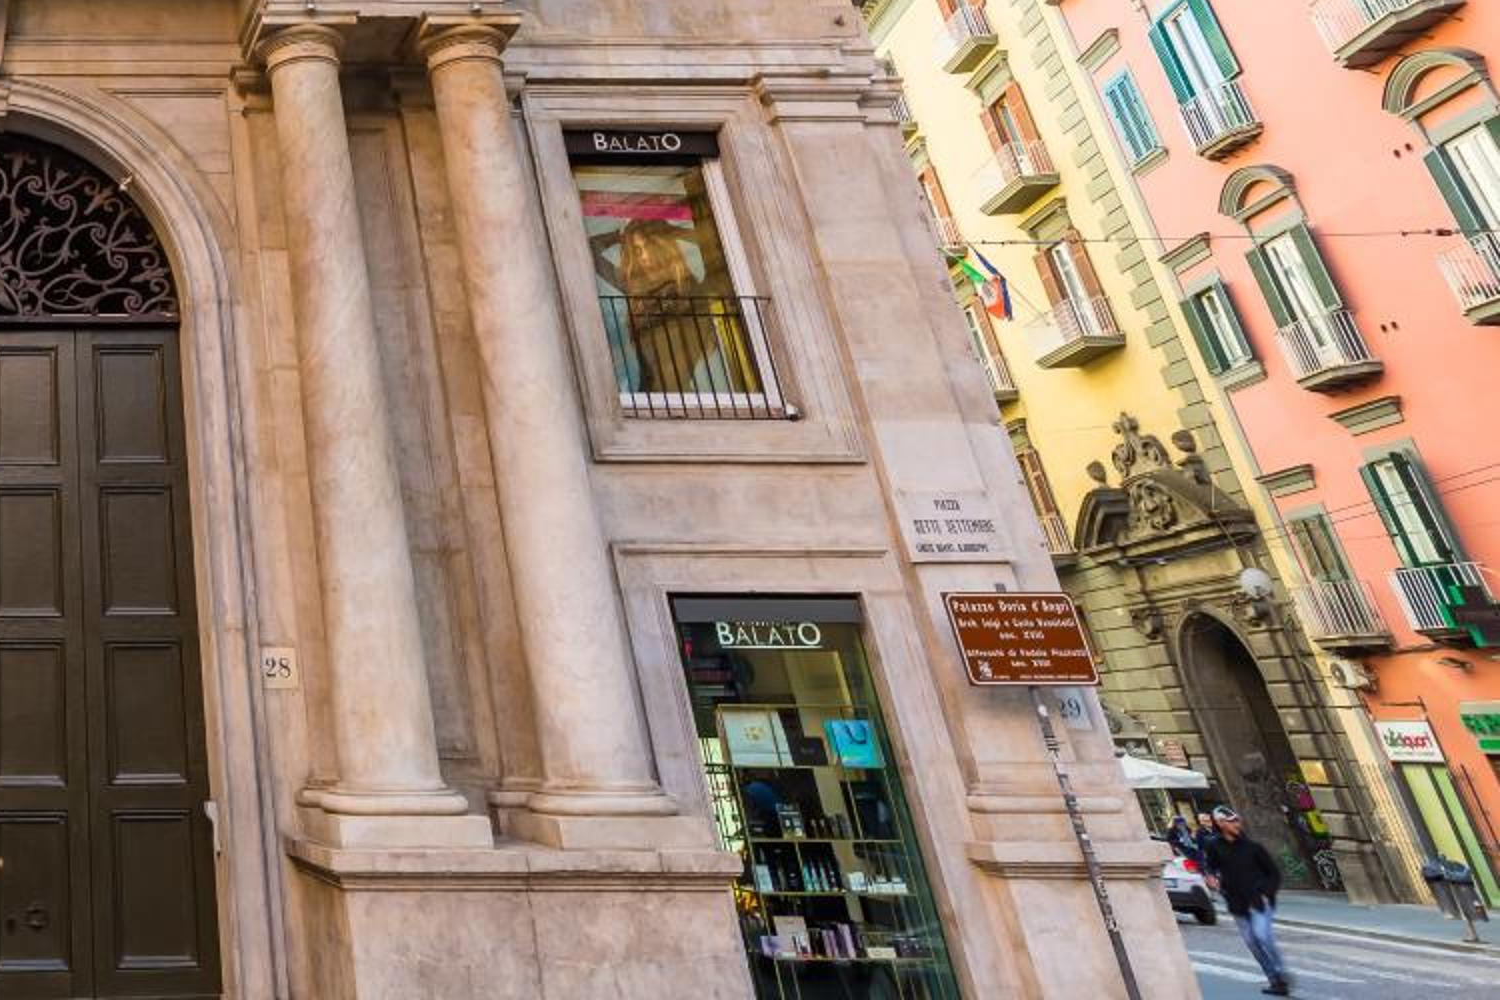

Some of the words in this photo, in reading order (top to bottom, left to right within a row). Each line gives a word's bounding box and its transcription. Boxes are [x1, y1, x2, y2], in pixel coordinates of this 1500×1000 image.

[593, 132, 681, 152] BALATO
[952, 599, 995, 613] Palazzo
[998, 599, 1027, 612] Doria
[715, 621, 821, 645] BALATO
[265, 656, 291, 679] 28
